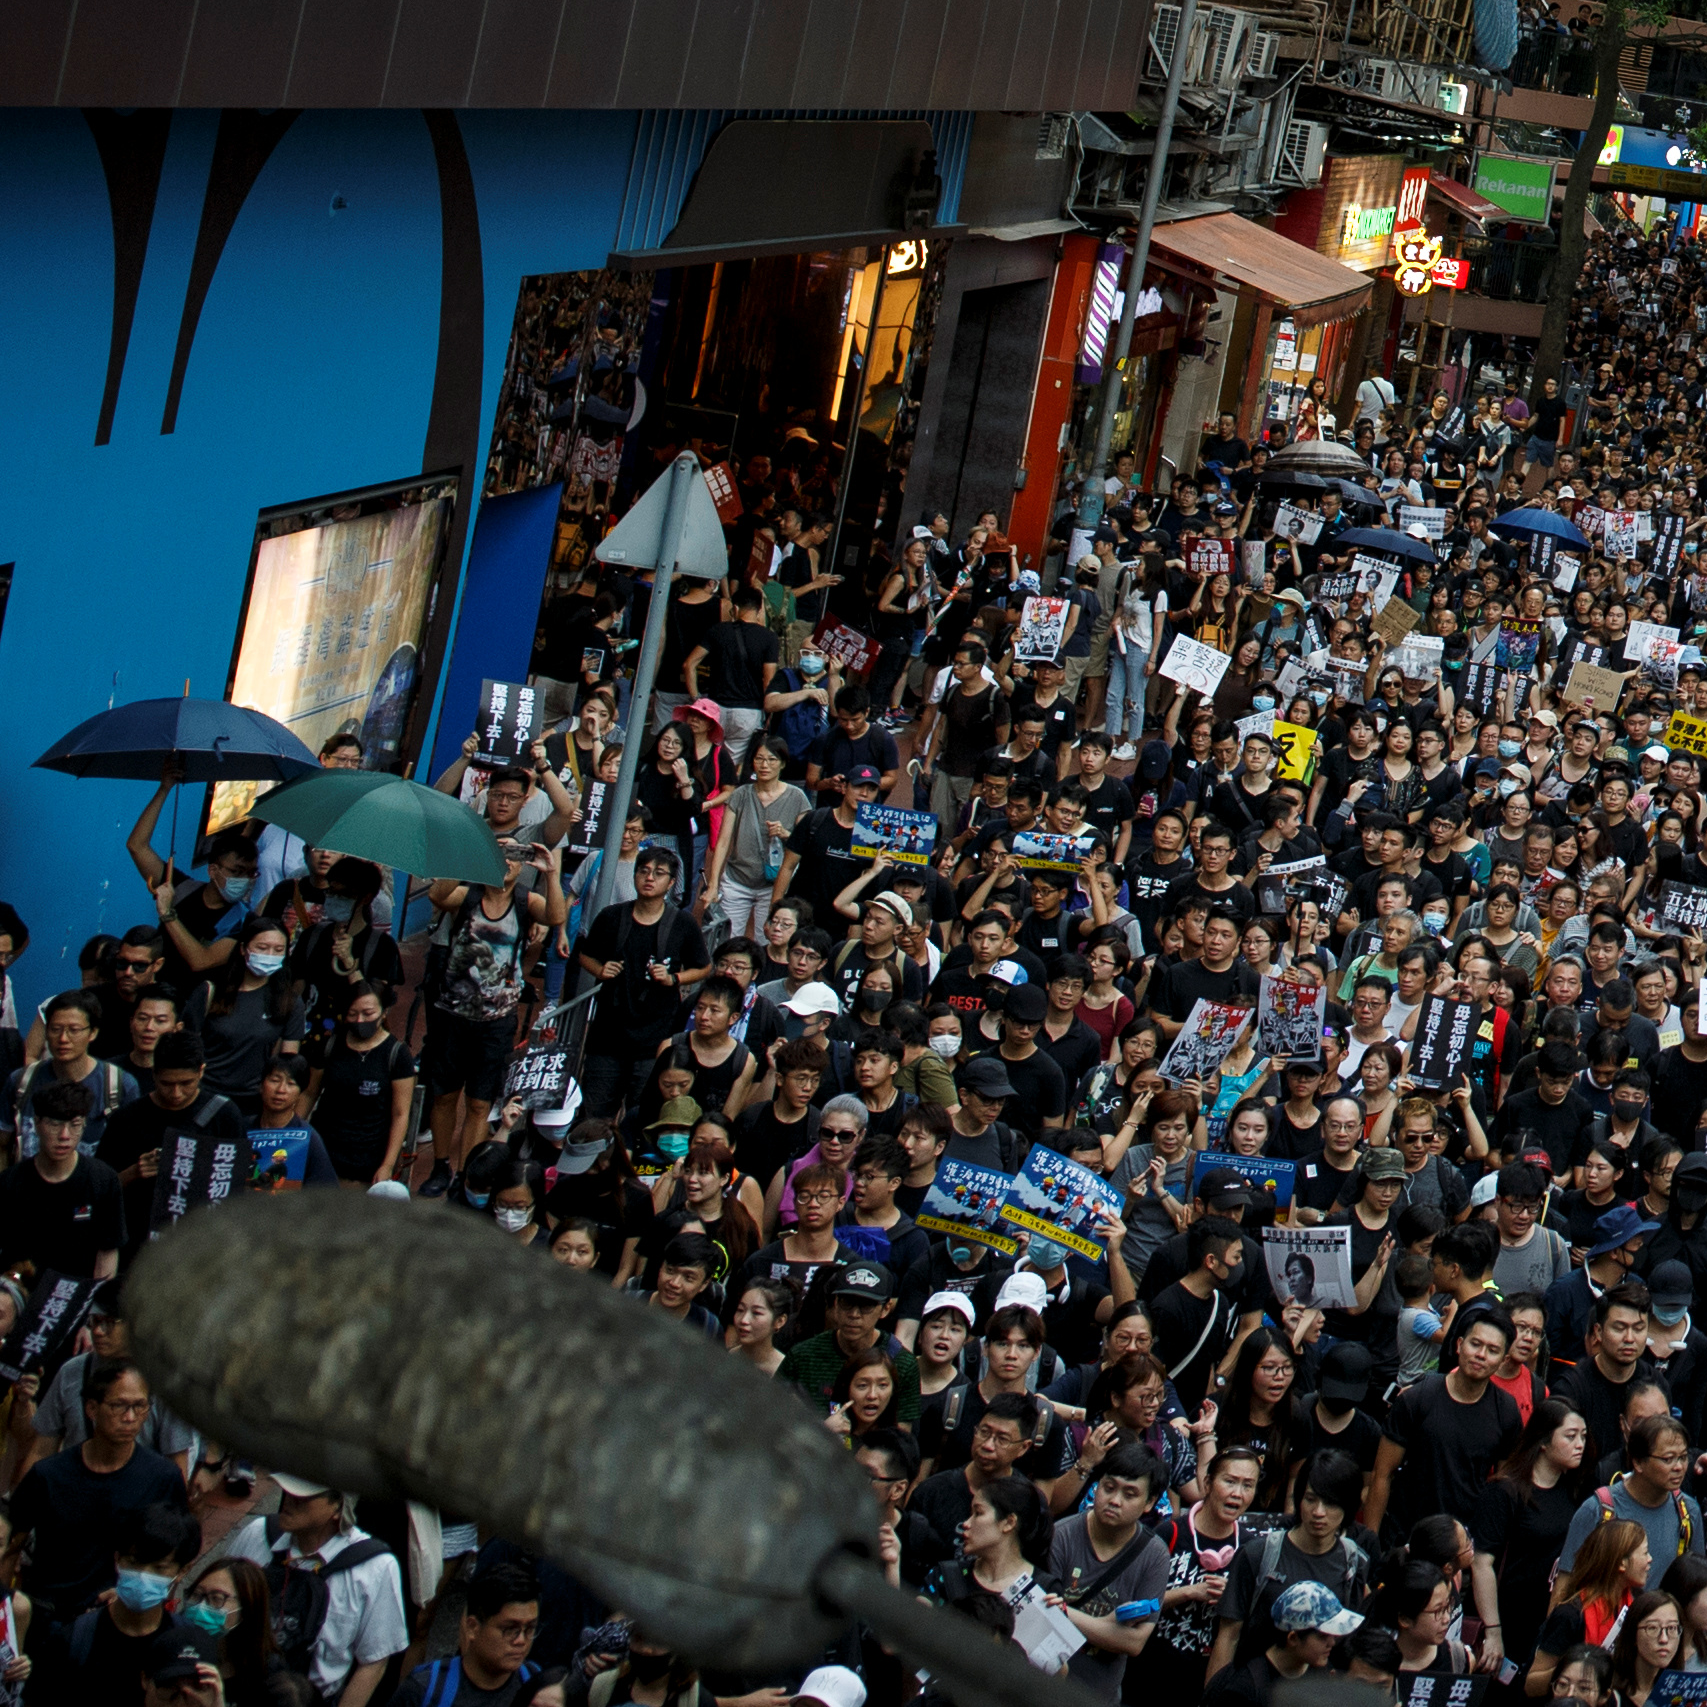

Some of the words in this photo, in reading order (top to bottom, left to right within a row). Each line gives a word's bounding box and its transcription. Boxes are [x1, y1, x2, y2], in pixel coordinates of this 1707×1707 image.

[1480, 175, 1547, 199] Rekanan
[486, 682, 508, 752] 堅持下去！
[513, 687, 536, 755] 毋忘初心！
[1672, 719, 1707, 739] 香港人
[584, 781, 607, 844] 堅持下去！
[1420, 997, 1445, 1075] 堅持下去！
[1445, 1004, 1471, 1078] 毋忘初心！
[168, 1136, 197, 1227] 堅持下去！
[208, 1143, 237, 1208] 毋忘初
[19, 1277, 80, 1368] 堅持下去！
